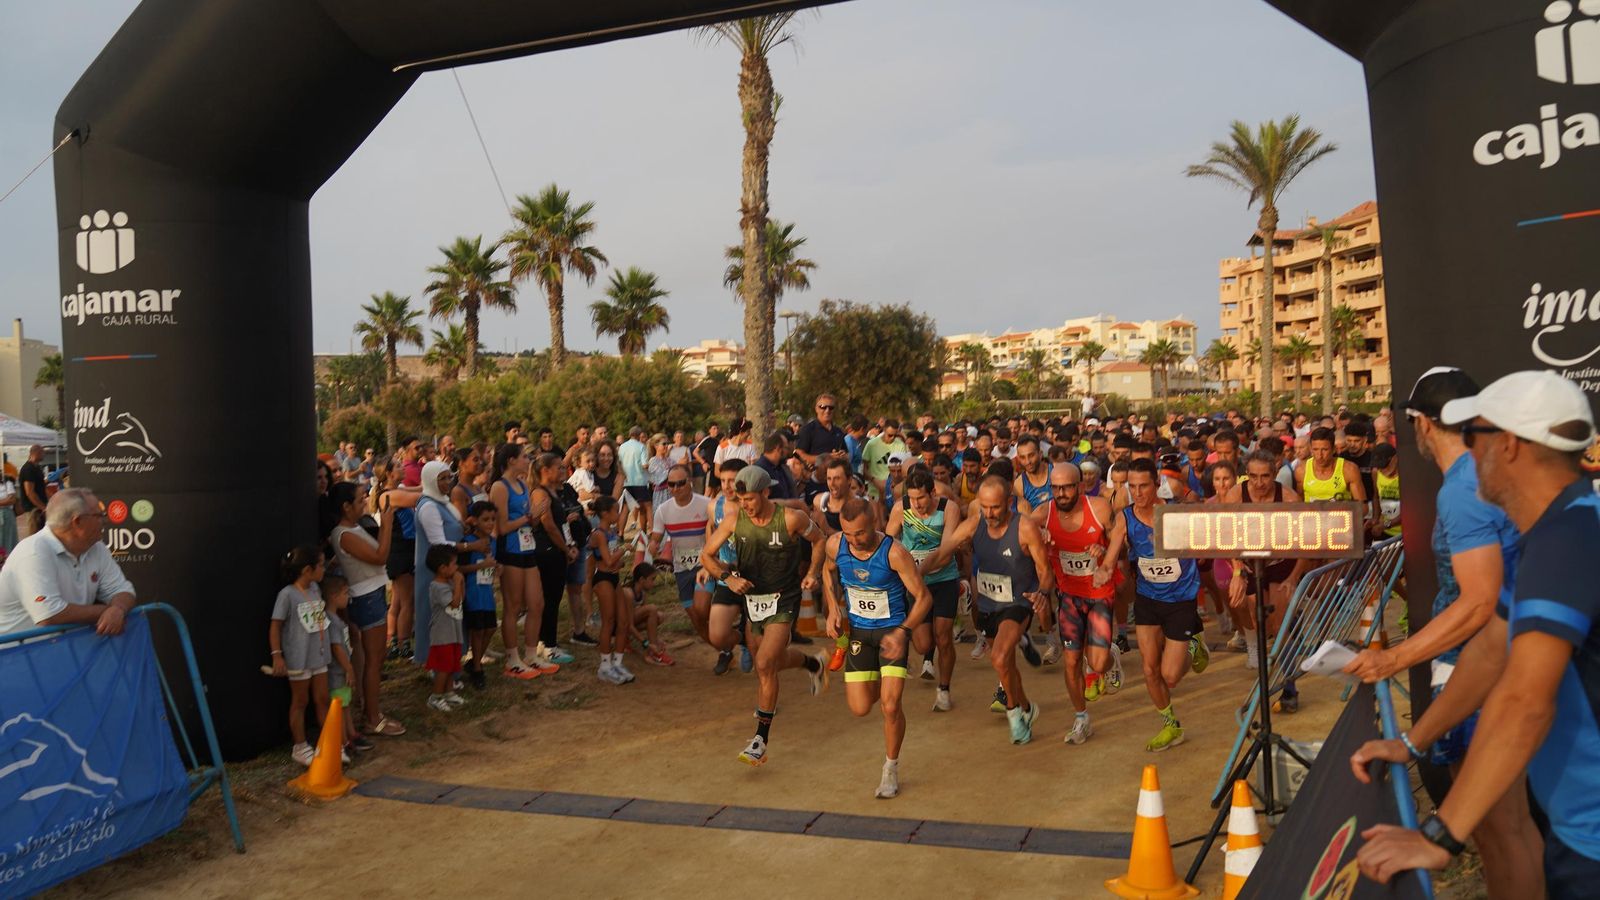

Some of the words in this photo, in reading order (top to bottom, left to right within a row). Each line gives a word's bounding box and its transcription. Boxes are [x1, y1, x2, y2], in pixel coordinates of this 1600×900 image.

[1473, 103, 1600, 169] caja
[62, 283, 181, 326] cajamar
[102, 315, 132, 326] CAJA
[135, 314, 178, 325] RURAL
[74, 397, 111, 428] imd
[108, 455, 142, 466] Municipal
[90, 465, 115, 475] Deportes
[125, 464, 134, 473] El
[134, 464, 155, 474] Ejido
[1189, 511, 1350, 551] 00:00:02
[102, 528, 155, 550] JIDO
[681, 555, 699, 564] 247
[1067, 559, 1091, 570] 107
[1148, 565, 1174, 576] 122
[981, 581, 1003, 593] 191
[858, 600, 876, 611] 86
